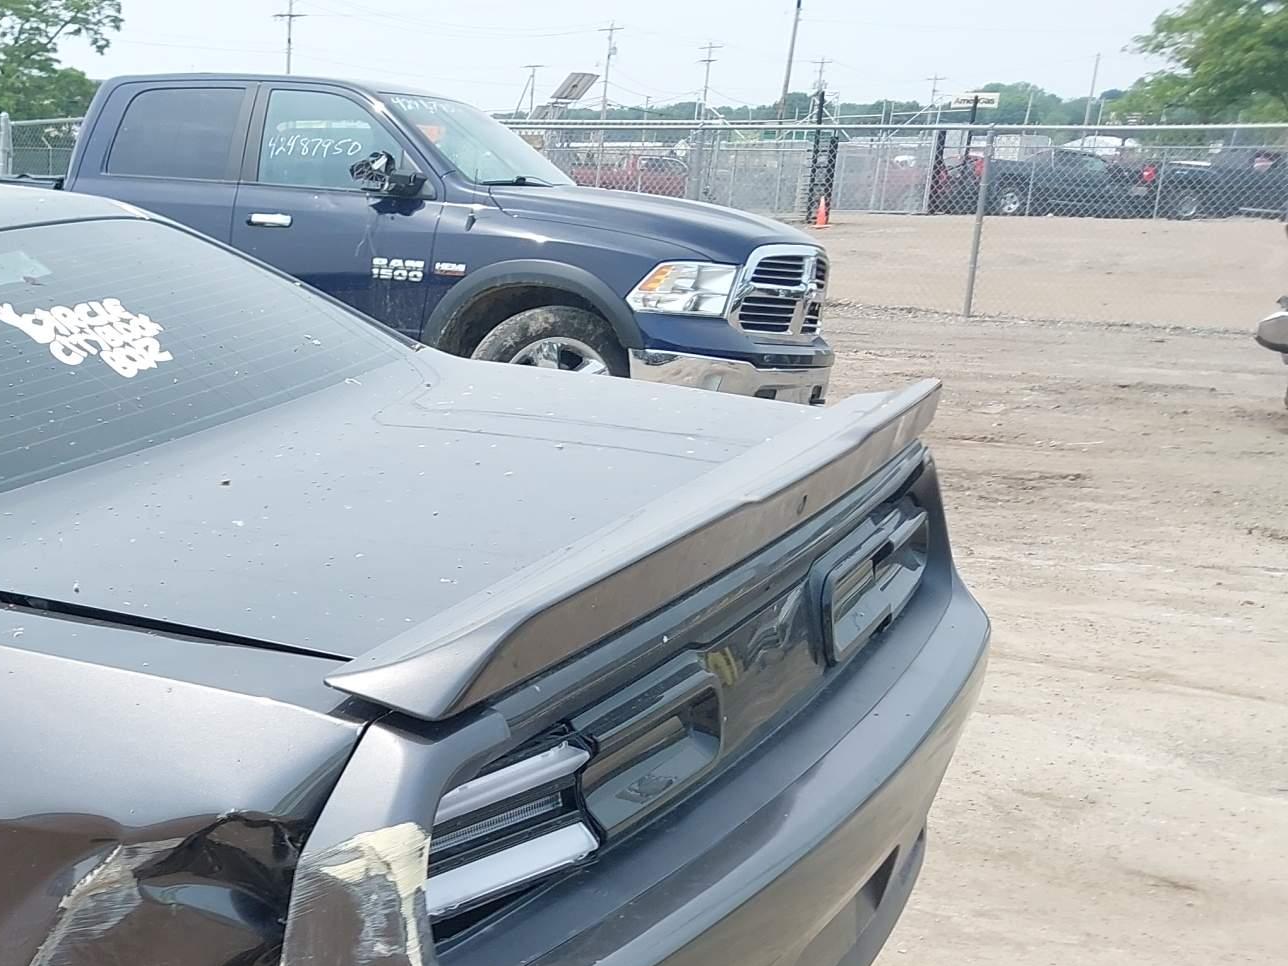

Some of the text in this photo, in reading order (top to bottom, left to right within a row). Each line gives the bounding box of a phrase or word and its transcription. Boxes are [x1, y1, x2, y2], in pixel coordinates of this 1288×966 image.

[268, 134, 362, 159] 42487950
[372, 257, 425, 270] RAM
[371, 268, 424, 282] 1500
